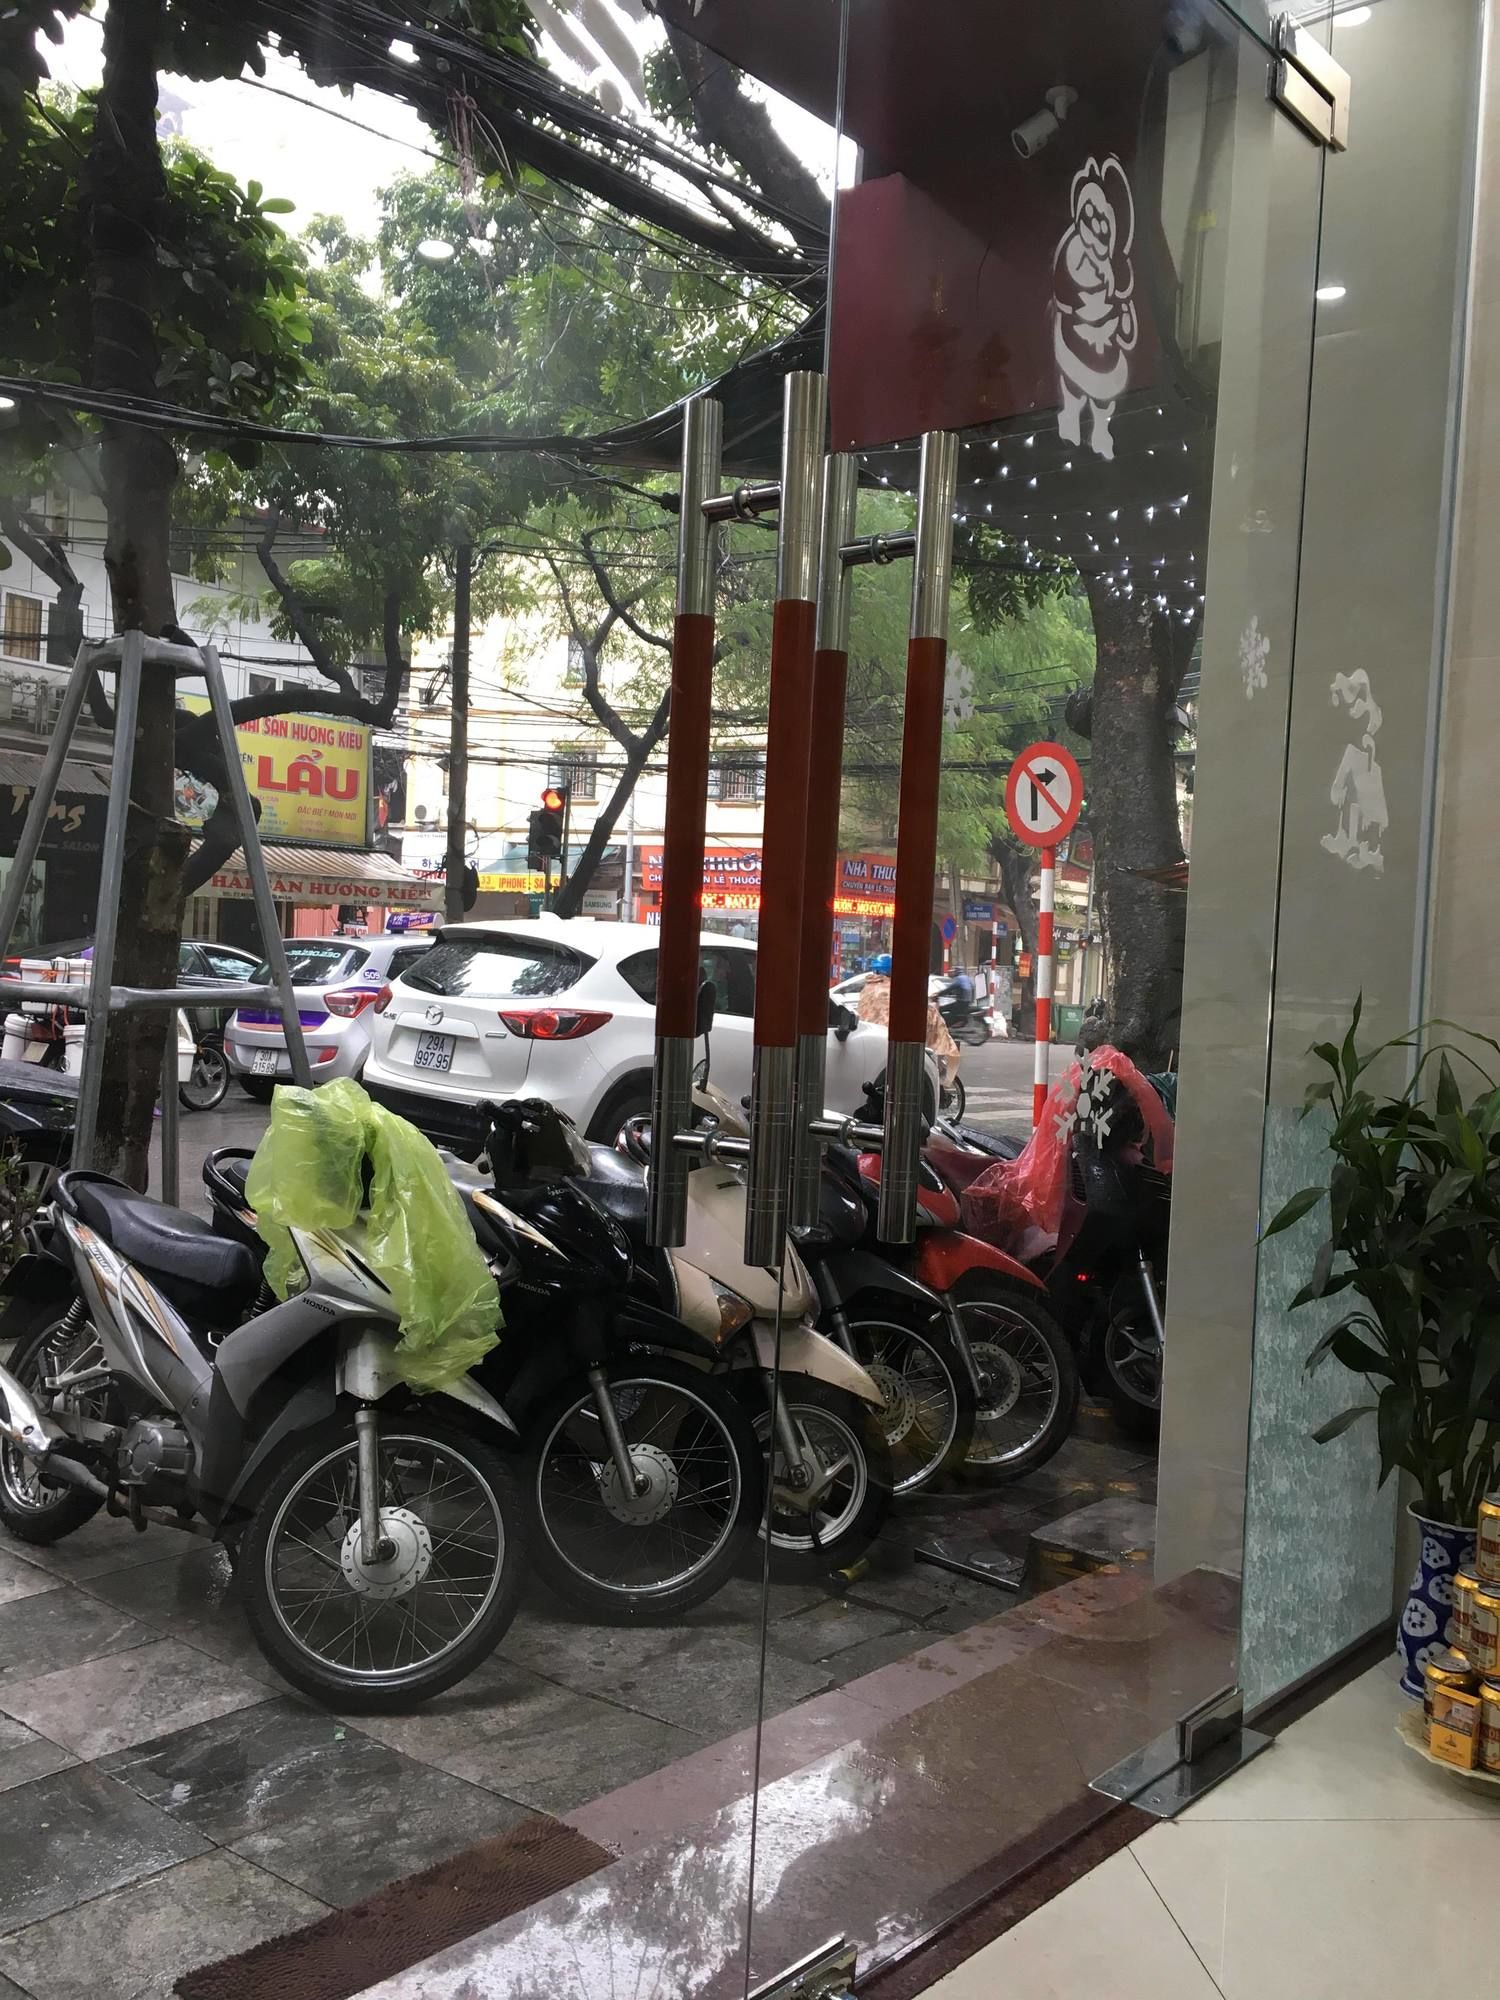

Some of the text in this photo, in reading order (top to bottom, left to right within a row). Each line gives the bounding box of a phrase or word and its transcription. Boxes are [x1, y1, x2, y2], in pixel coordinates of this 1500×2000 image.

[257, 749, 360, 801] LẨU
[426, 1035, 446, 1053] 29A
[415, 1050, 450, 1070] 997.95
[302, 1296, 336, 1316] HONDA
